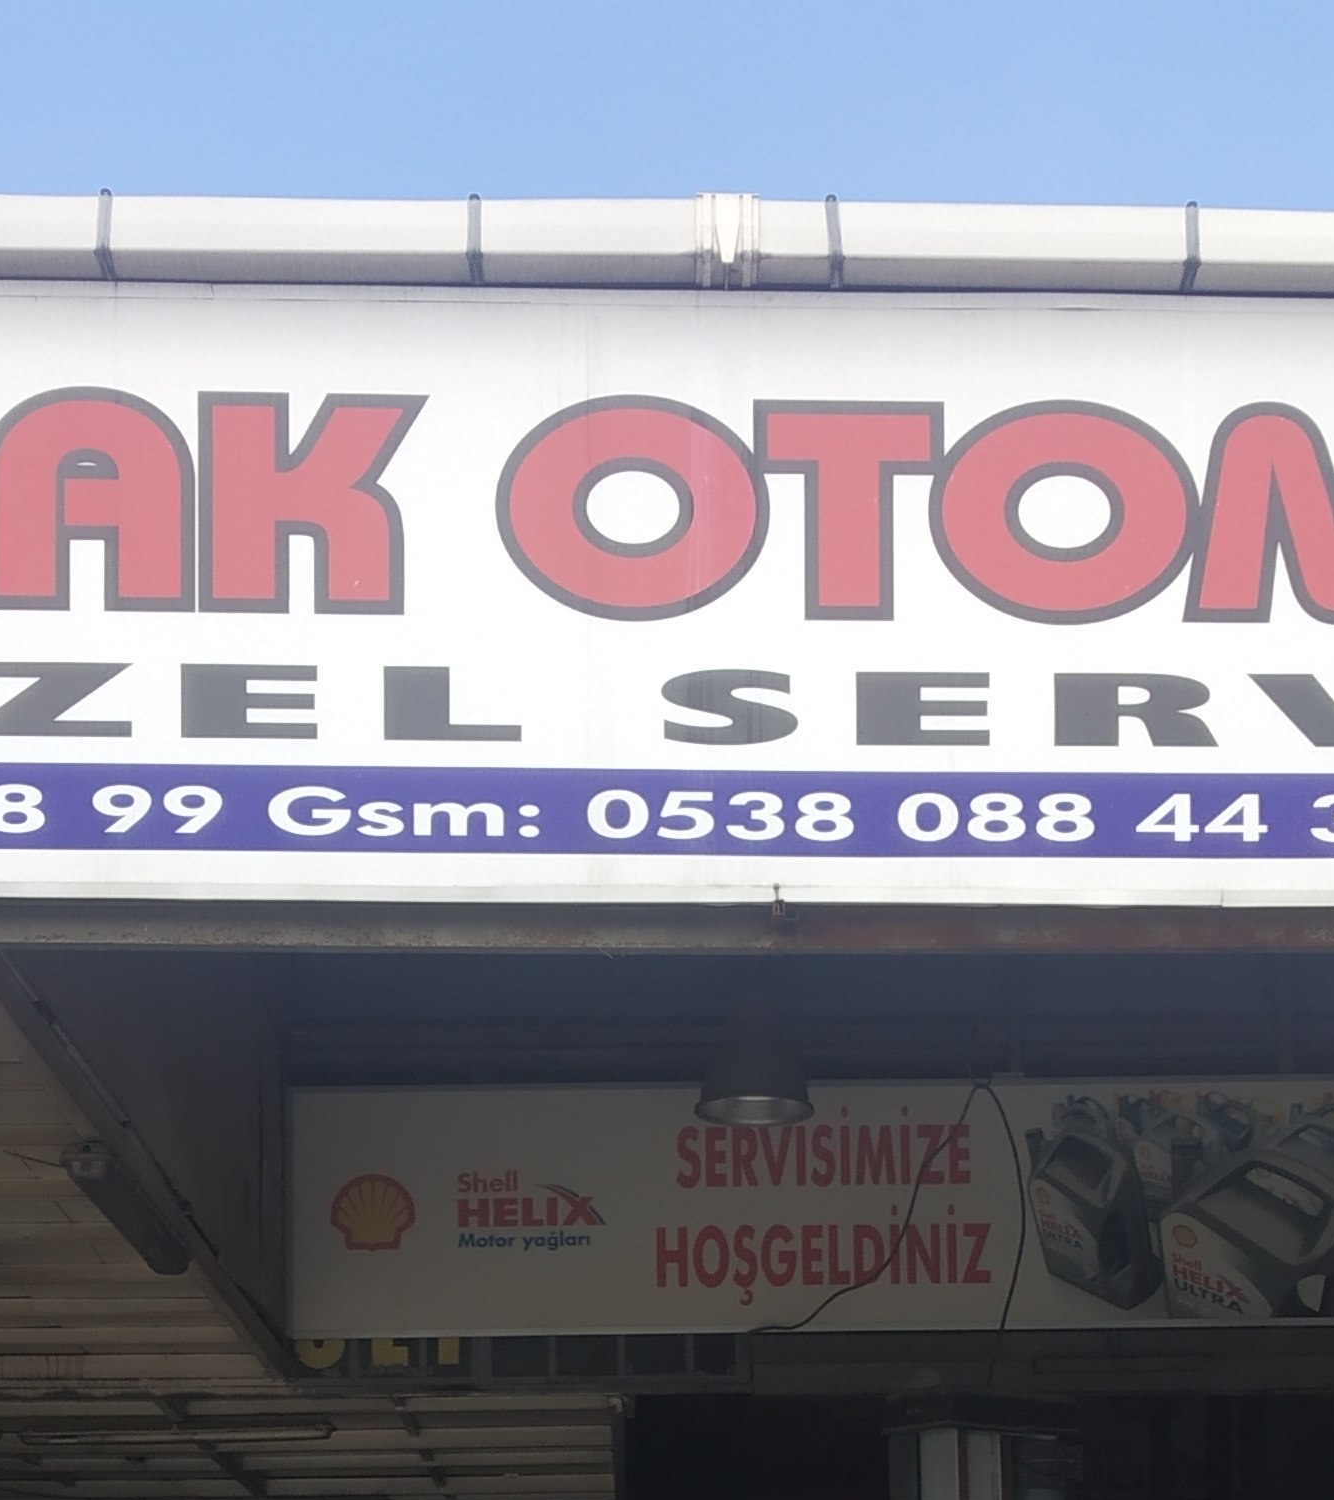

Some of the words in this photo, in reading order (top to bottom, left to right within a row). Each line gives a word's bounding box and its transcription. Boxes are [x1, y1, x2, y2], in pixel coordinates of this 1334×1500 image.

[92, 784, 222, 836] 99
[268, 786, 540, 839] Gsm:
[586, 788, 854, 842] 0538
[896, 791, 1095, 843] 088
[1136, 792, 1268, 843] 44
[457, 1169, 519, 1193] Shell
[456, 1194, 605, 1228] HELIX
[457, 1231, 516, 1249] Motor
[522, 1230, 592, 1251] yağları
[656, 1203, 992, 1306] HOŞGELDİNİZ
[1172, 1263, 1247, 1302] HELIX
[1174, 1278, 1244, 1315] ULTRA
